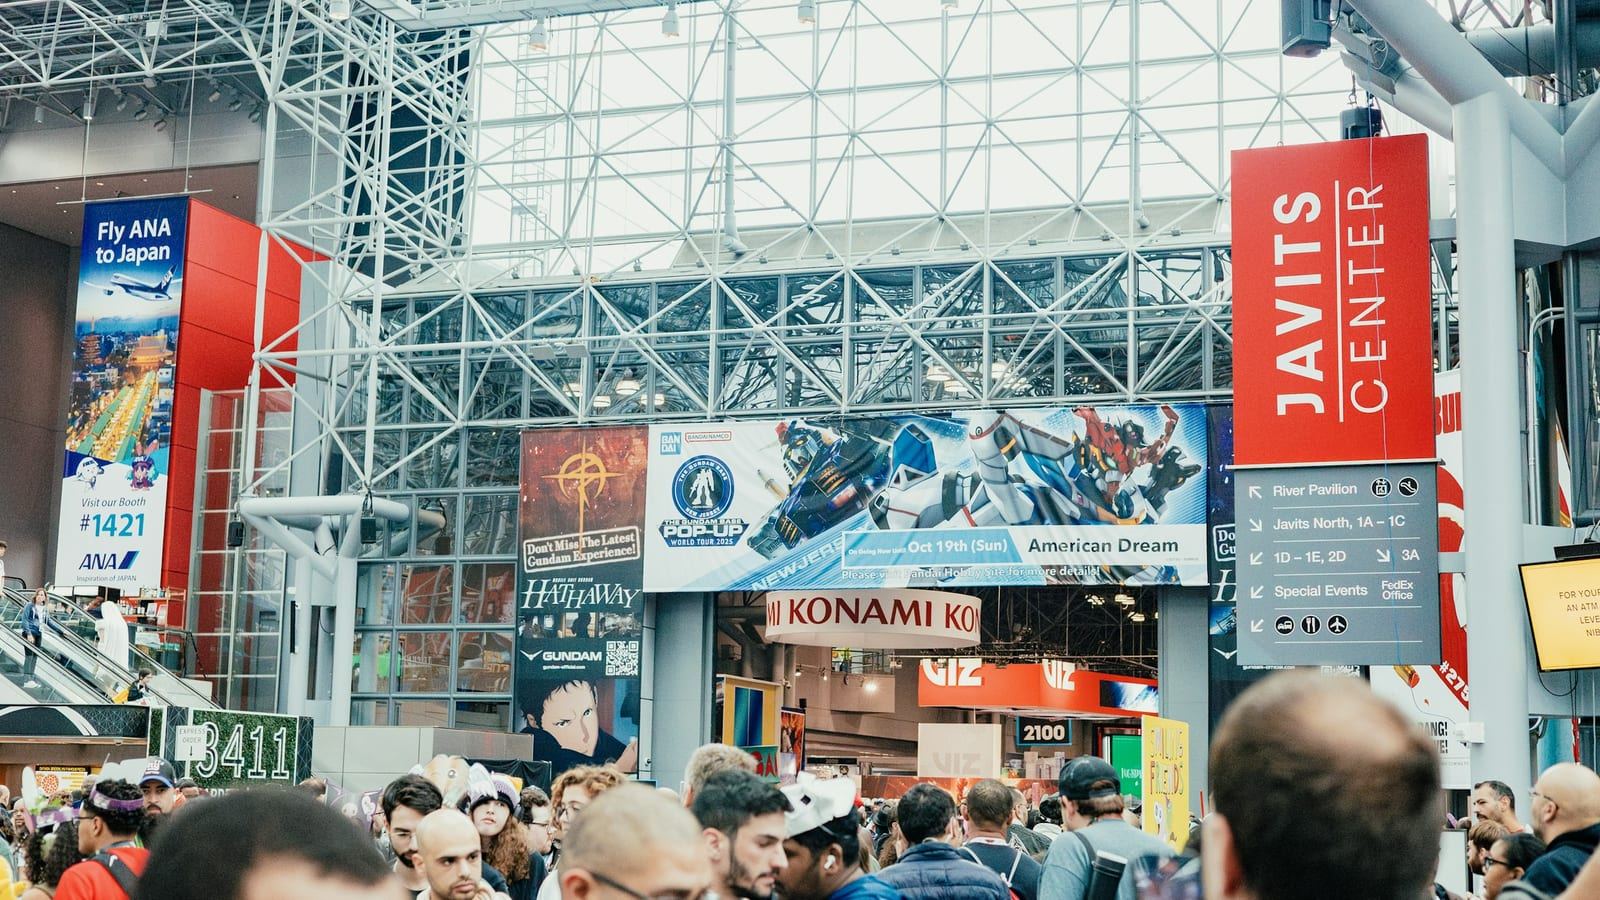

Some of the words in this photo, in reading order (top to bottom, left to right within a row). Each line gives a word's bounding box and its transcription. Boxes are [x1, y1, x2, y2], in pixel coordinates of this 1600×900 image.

[97, 221, 125, 245] Fly
[129, 218, 171, 239] ANA
[96, 247, 115, 264] to
[117, 244, 170, 266] Japan
[1272, 191, 1325, 416] JAVITS
[1347, 184, 1388, 414] CENTER
[662, 435, 680, 444] BAN
[662, 444, 677, 453] DAI
[1273, 485, 1305, 496] River
[1309, 484, 1357, 495] Pavilion
[82, 498, 99, 508] Visit
[101, 499, 117, 507] our
[119, 497, 146, 507] Booth
[80, 513, 145, 537] #1421
[1273, 518, 1309, 530] Javits
[1313, 517, 1352, 530] North,
[1357, 516, 1373, 527] 1A
[1388, 515, 1405, 527] 1C
[663, 525, 743, 538] POP-UP
[527, 541, 554, 555] Don't
[555, 540, 579, 552] Miss
[580, 536, 600, 548] The
[601, 532, 635, 546] Latest
[671, 538, 695, 546] WORLD
[908, 541, 932, 553] Oct
[936, 540, 970, 552] 19th
[971, 539, 1008, 554] (Sun)
[1028, 538, 1112, 553] American
[1118, 538, 1179, 553] Dream
[79, 553, 117, 570] ANA
[528, 553, 571, 567] Gundam
[573, 544, 636, 563] Experience!
[1274, 552, 1291, 563] 1D
[1305, 551, 1324, 564] 1E,
[1328, 551, 1346, 562] 2D
[1402, 549, 1420, 561] 3A
[842, 570, 875, 579] Please
[944, 567, 983, 579] Hobby
[985, 568, 1005, 577] Site
[1009, 566, 1023, 575] for
[1026, 568, 1056, 576] more
[1059, 566, 1100, 577] details!
[1274, 585, 1320, 598] Special
[1325, 585, 1368, 596] Events
[1381, 580, 1413, 590] FedEx
[520, 579, 641, 609] HATHAWAY
[1382, 590, 1413, 600] Office
[1559, 591, 1577, 599] FOR
[789, 597, 932, 627] KONAMI
[1567, 604, 1578, 612] AN
[1581, 602, 1599, 611] ATM
[542, 651, 602, 662] GUNDAM
[920, 658, 982, 686] VIZ
[1042, 658, 1075, 691] VIZ
[1023, 725, 1065, 741] 2100
[196, 721, 290, 779] 3411
[932, 752, 981, 775] VIZ
